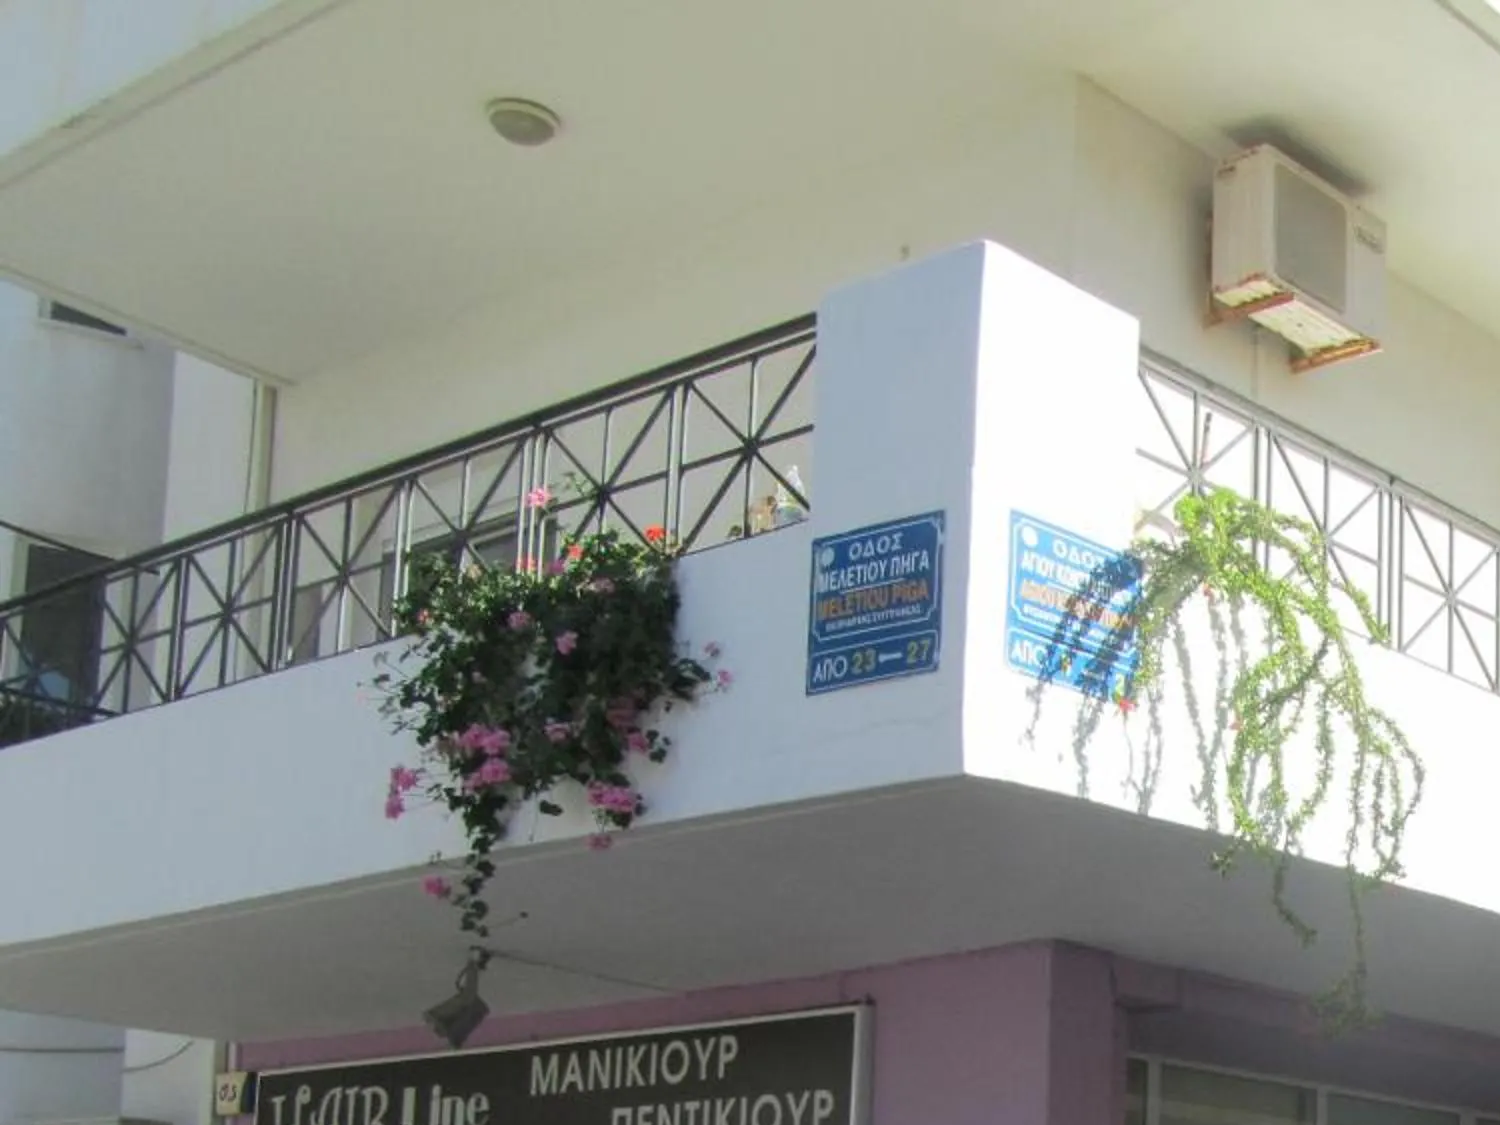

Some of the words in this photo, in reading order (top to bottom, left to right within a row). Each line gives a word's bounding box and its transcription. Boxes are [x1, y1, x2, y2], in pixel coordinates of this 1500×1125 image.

[849, 532, 903, 560] ΟΔΟΣ
[890, 549, 930, 577] ΠΗΓΑ
[813, 655, 848, 682] ΑΠΟ
[907, 637, 931, 664] 27
[530, 1034, 739, 1096] ΜΑΝΙΚΙΟΥΡ
